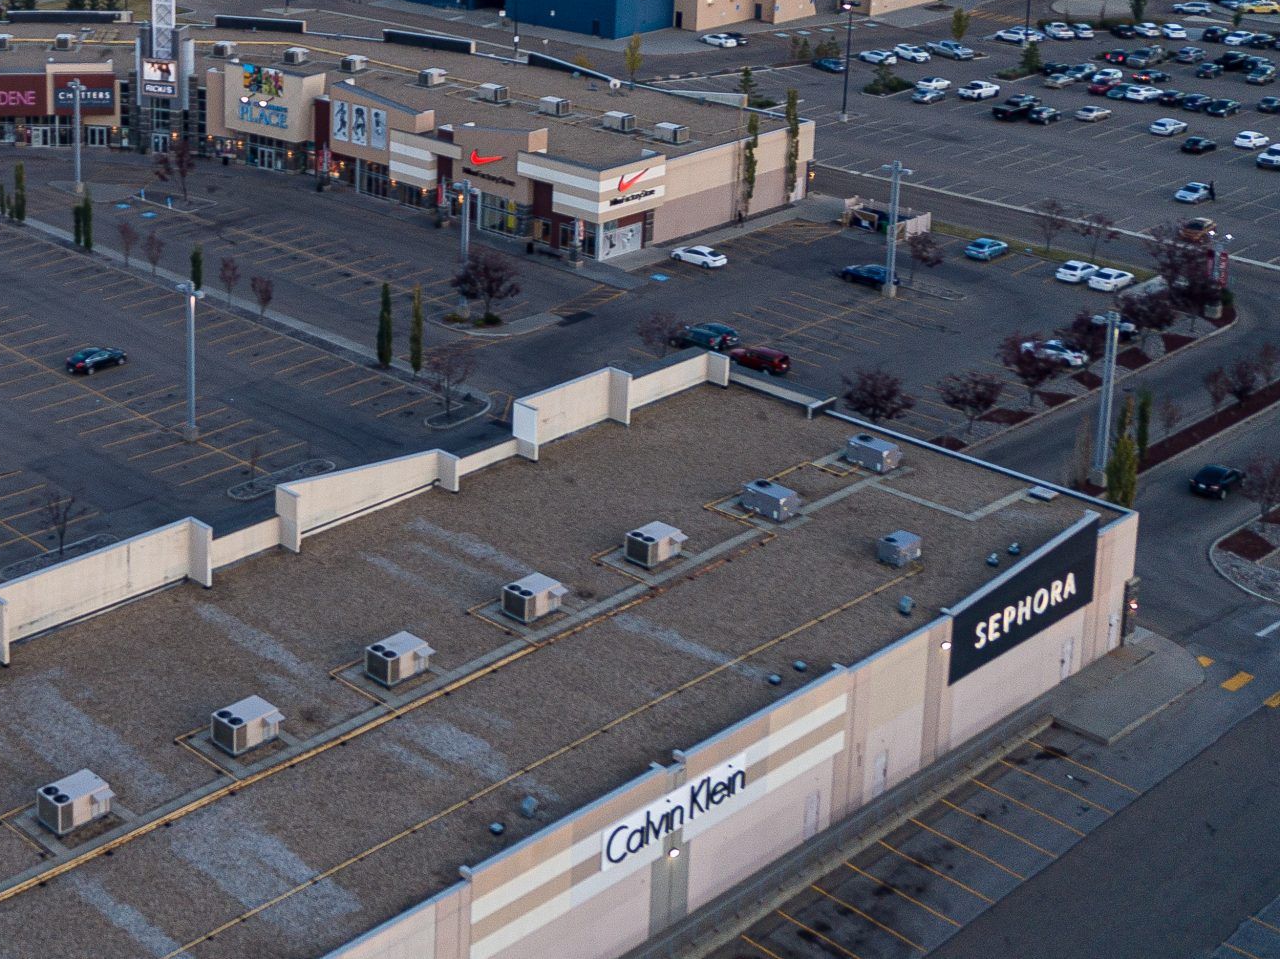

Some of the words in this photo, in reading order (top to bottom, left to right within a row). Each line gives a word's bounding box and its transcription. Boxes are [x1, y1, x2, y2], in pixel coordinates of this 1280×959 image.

[57, 91, 111, 100] CHTTERS
[239, 103, 288, 129] PLACE
[974, 572, 1077, 650] SEPHORA
[606, 798, 685, 864] Calvin
[688, 764, 746, 820] Klein
